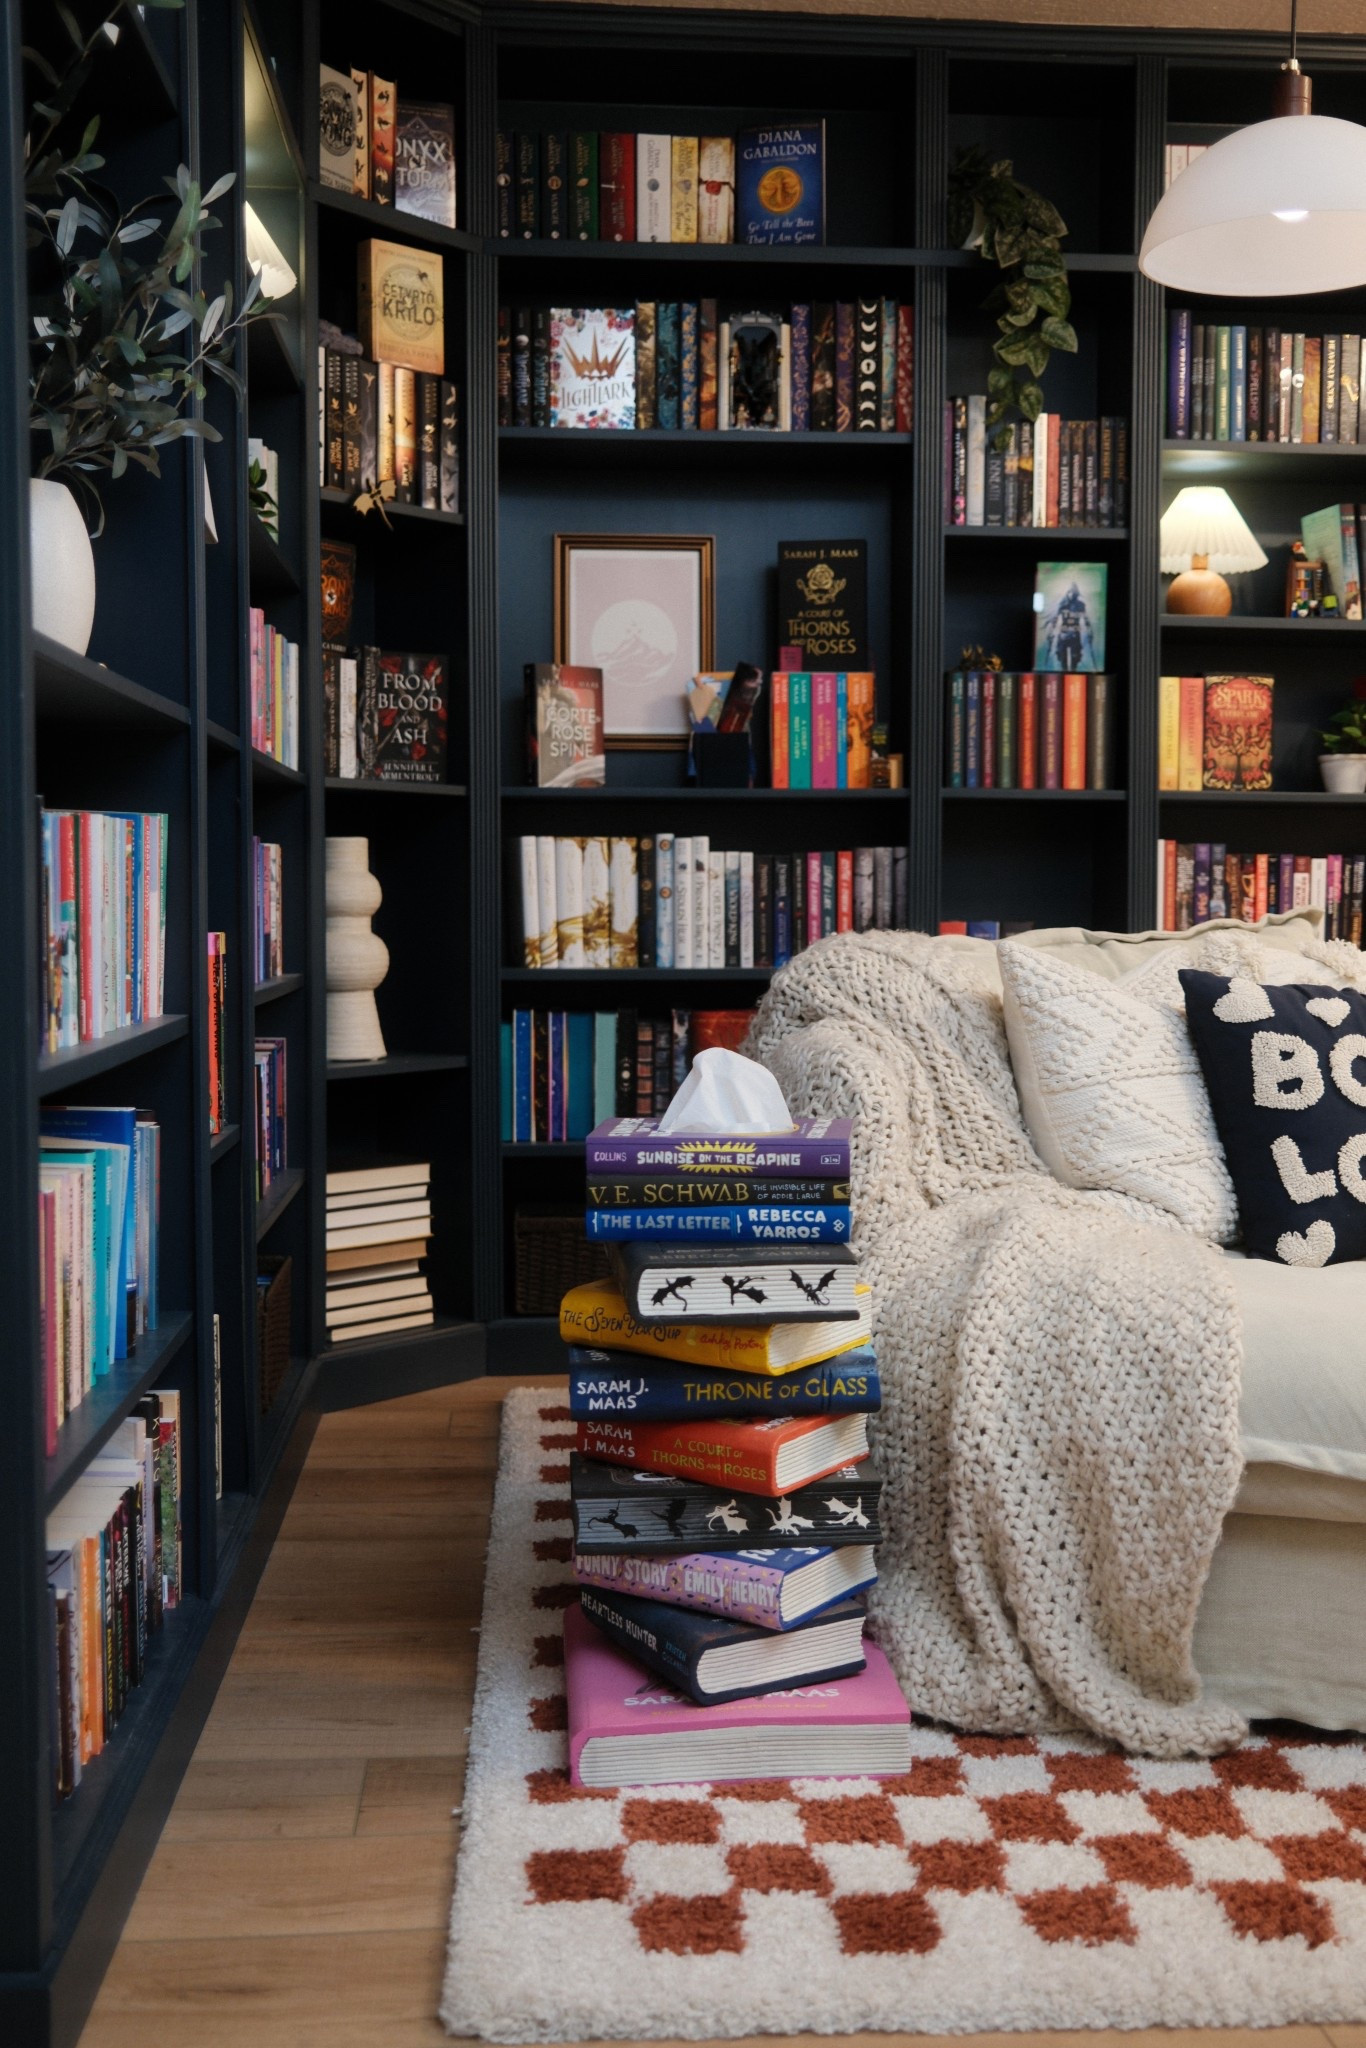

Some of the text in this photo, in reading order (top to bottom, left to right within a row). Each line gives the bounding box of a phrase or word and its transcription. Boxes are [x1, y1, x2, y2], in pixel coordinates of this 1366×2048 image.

[759, 130, 802, 144] DIANA
[743, 143, 817, 160] GABALDON
[784, 550, 817, 559] SARAH
[830, 548, 859, 558] MAAS
[787, 619, 850, 636] THORNS
[806, 638, 857, 656] ROSES
[382, 672, 437, 691] FROM
[377, 693, 443, 713] BLOOD
[401, 714, 420, 724] AND
[390, 728, 428, 745] ASH
[551, 724, 593, 742] ROSE
[550, 741, 593, 758] SPINE
[594, 1151, 627, 1162] COLLINS
[637, 1151, 801, 1166] SUNRISE ON THE REAPING
[643, 1183, 749, 1203] SCHWAB
[601, 1214, 731, 1230] THE LAST LETTER
[748, 1208, 827, 1223] REBECCA
[751, 1225, 821, 1239] YARROS
[563, 1310, 582, 1327] THE
[577, 1378, 649, 1396] SARAH J.
[683, 1377, 868, 1402] THRONE OF GLASS
[588, 1395, 637, 1411] MAAS
[586, 1421, 633, 1441] SARAH
[152, 1416, 161, 1482] KING
[596, 1441, 636, 1458] MAAS
[673, 1438, 683, 1449] A
[688, 1440, 733, 1458] COURT
[652, 1450, 705, 1471] THORNS
[723, 1462, 768, 1481] ROSES
[576, 1555, 778, 1608] FUNNY STORY EMILY HENRY
[581, 1592, 658, 1653] HEARTLESS HUNTER
